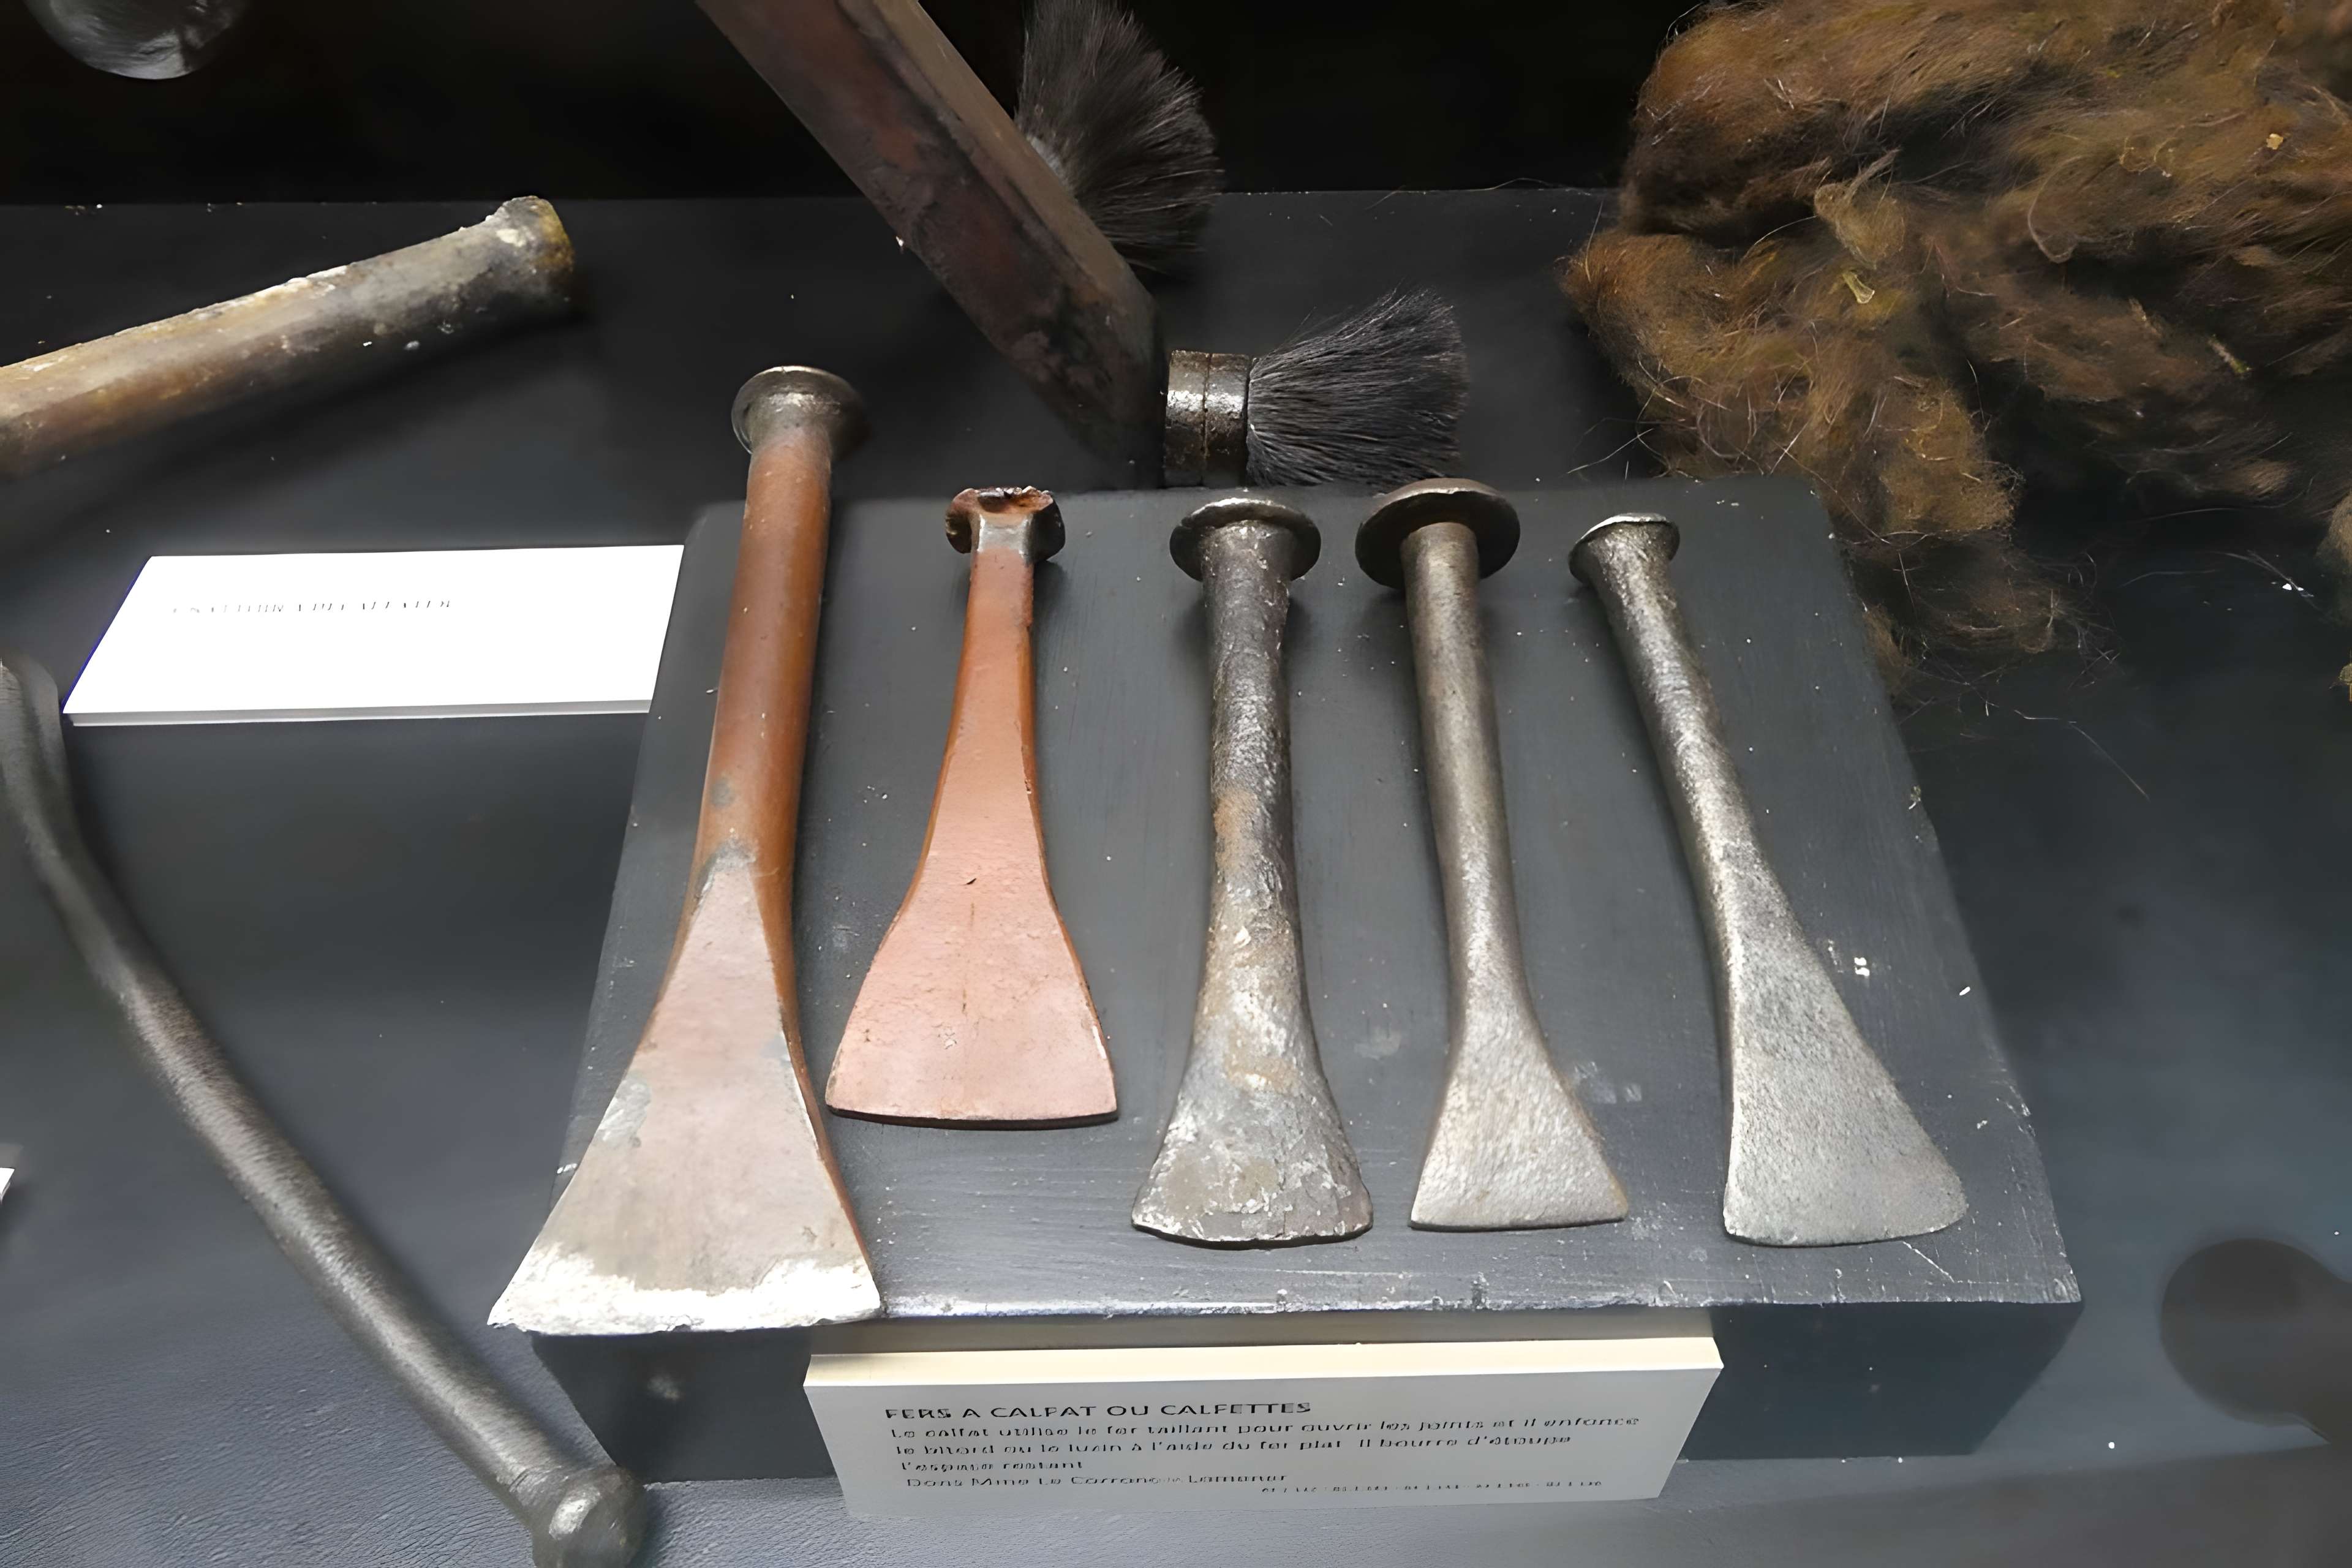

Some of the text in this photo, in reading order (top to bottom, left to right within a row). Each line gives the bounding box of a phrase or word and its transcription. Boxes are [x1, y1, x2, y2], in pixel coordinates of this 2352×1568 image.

[885, 1408, 951, 1419] FERS
[1107, 1406, 1149, 1415] OU
[1161, 1403, 1311, 1414] CALFETTES
